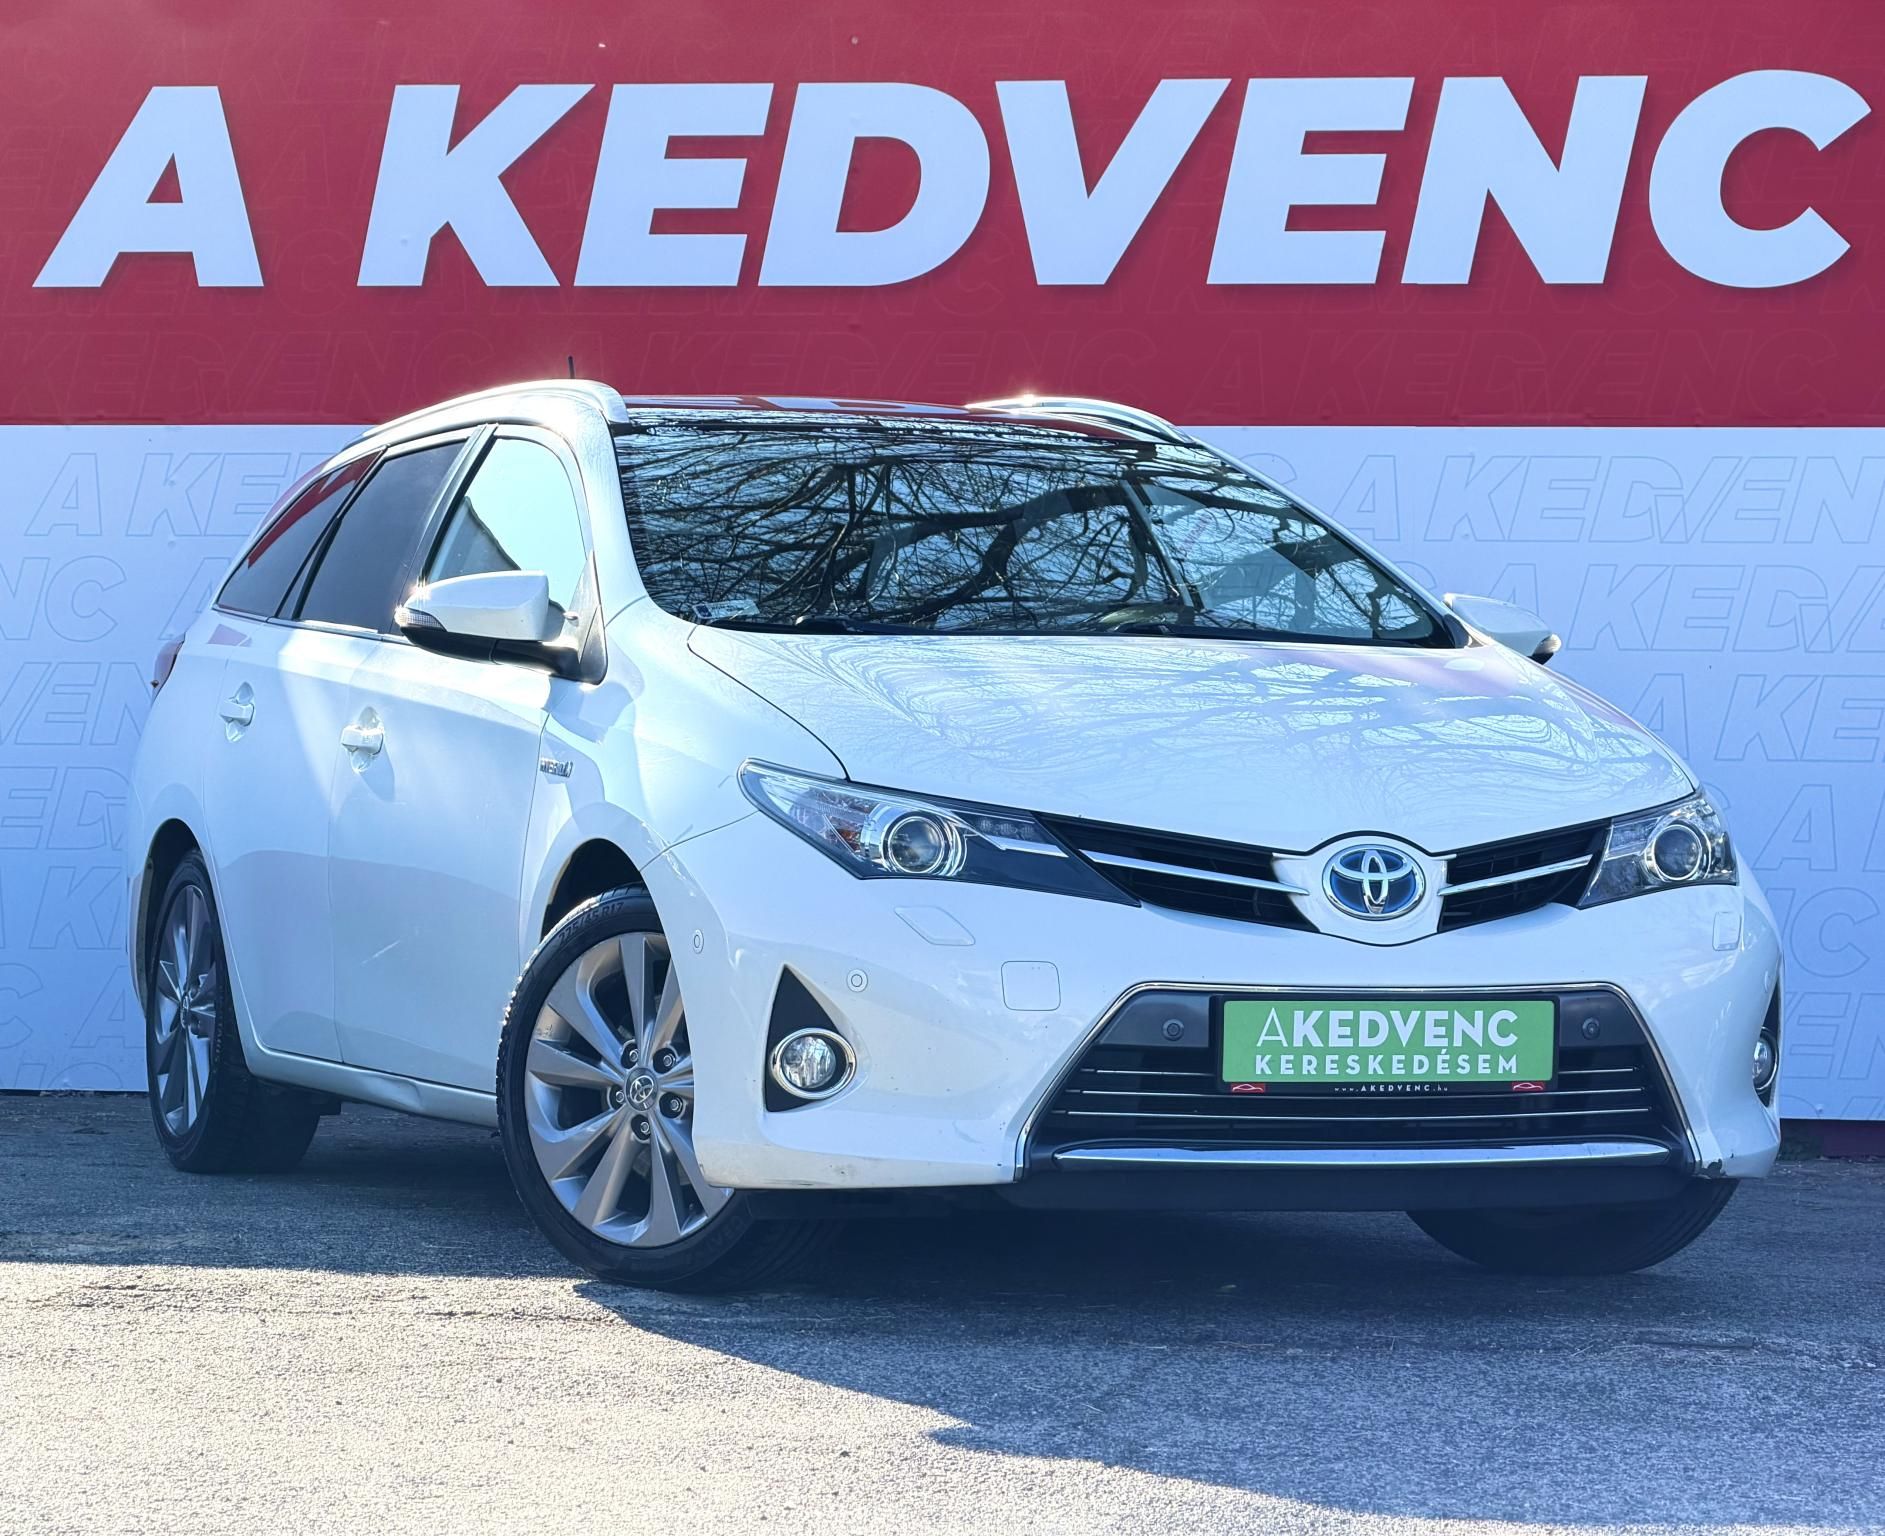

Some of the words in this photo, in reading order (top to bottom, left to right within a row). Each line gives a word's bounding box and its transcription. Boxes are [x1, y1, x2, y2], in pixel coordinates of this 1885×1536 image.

[32, 85, 264, 287] A
[357, 69, 1873, 288] KEDVENC
[24, 452, 103, 537] A
[1255, 1048, 1518, 1076] KERESKEDÉSEM
